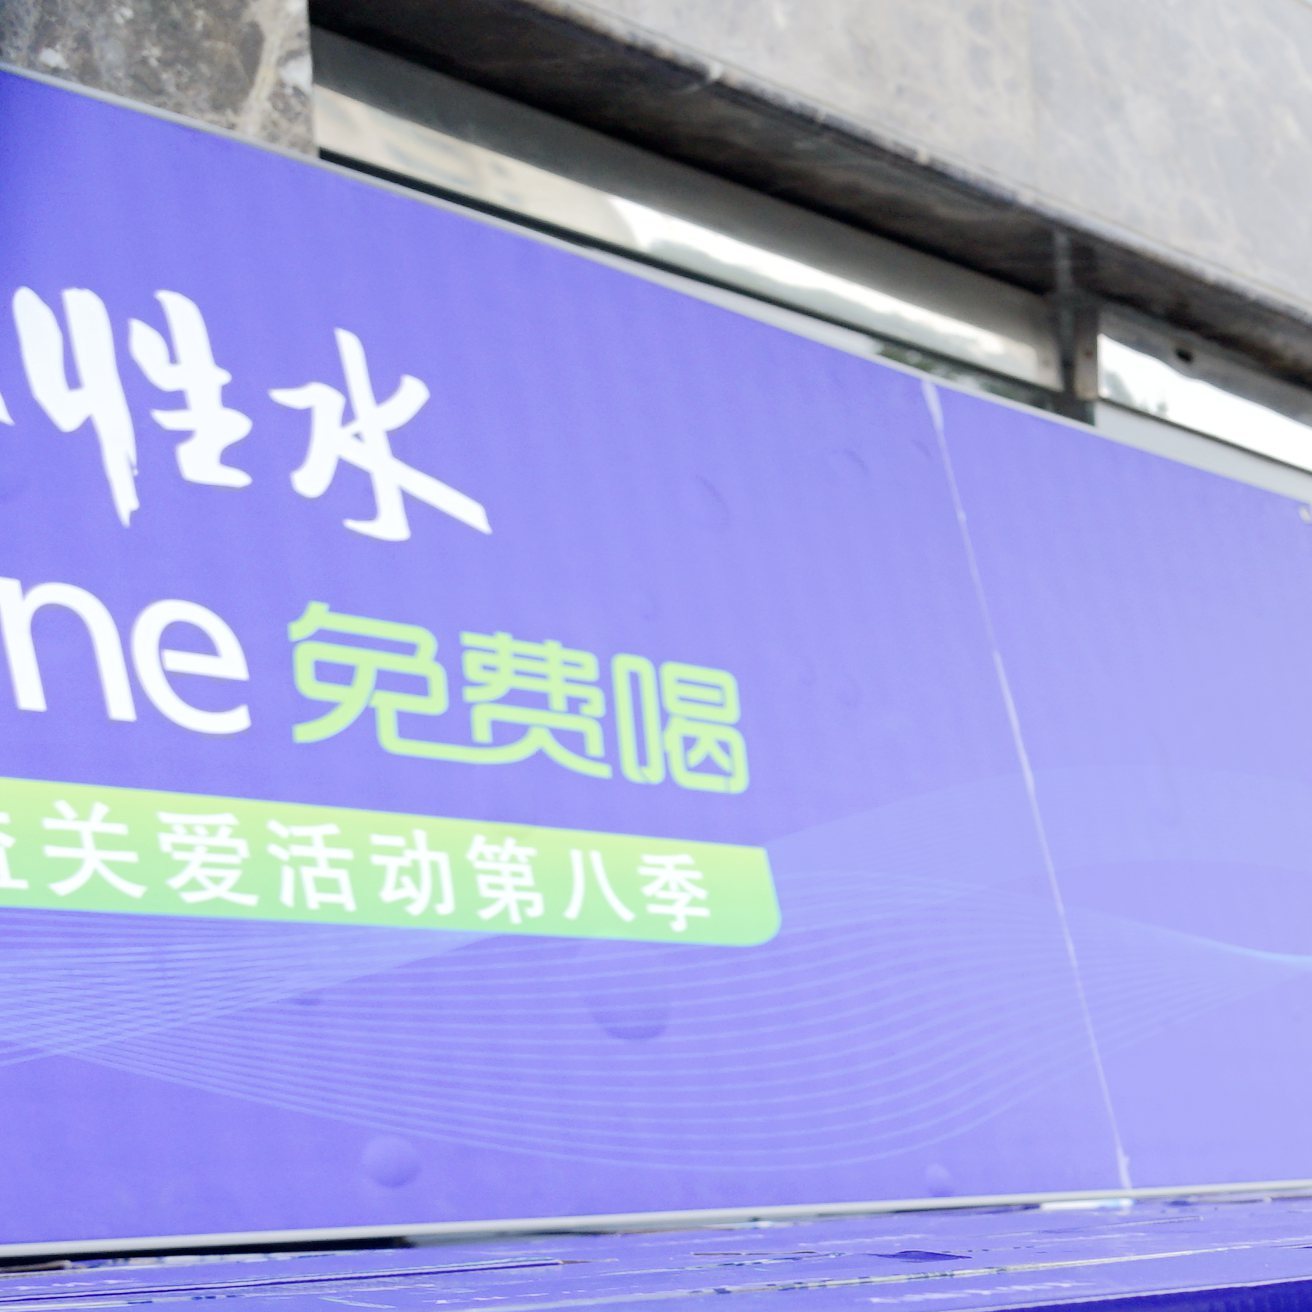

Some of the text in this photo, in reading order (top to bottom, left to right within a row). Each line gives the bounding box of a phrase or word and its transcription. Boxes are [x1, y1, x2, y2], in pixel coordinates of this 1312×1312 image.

[0, 286, 492, 542] 性水
[287, 601, 750, 795] 免费喝
